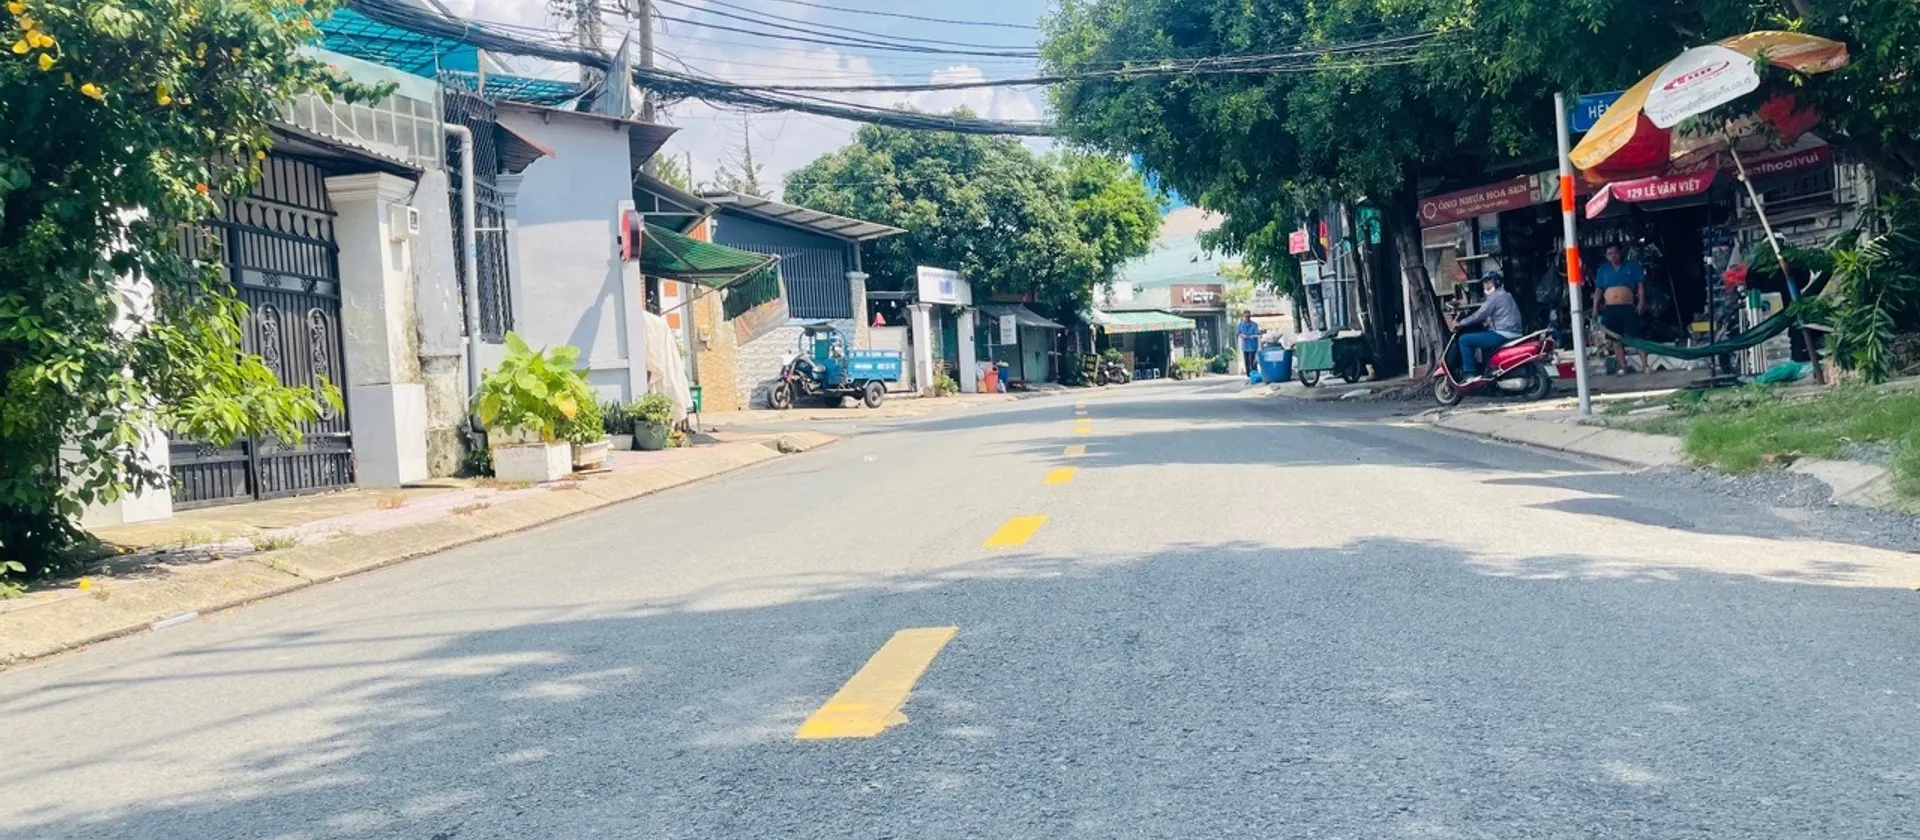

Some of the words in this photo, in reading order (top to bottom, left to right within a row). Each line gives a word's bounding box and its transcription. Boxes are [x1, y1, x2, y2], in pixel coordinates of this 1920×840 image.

[1588, 100, 1611, 118] HẺ
[1486, 189, 1506, 199] HOA
[1507, 183, 1527, 195] SEN
[1626, 188, 1642, 199] 129
[1644, 183, 1656, 197] LÊ
[1657, 182, 1678, 195] VĂN
[1679, 178, 1700, 192] VIỆT
